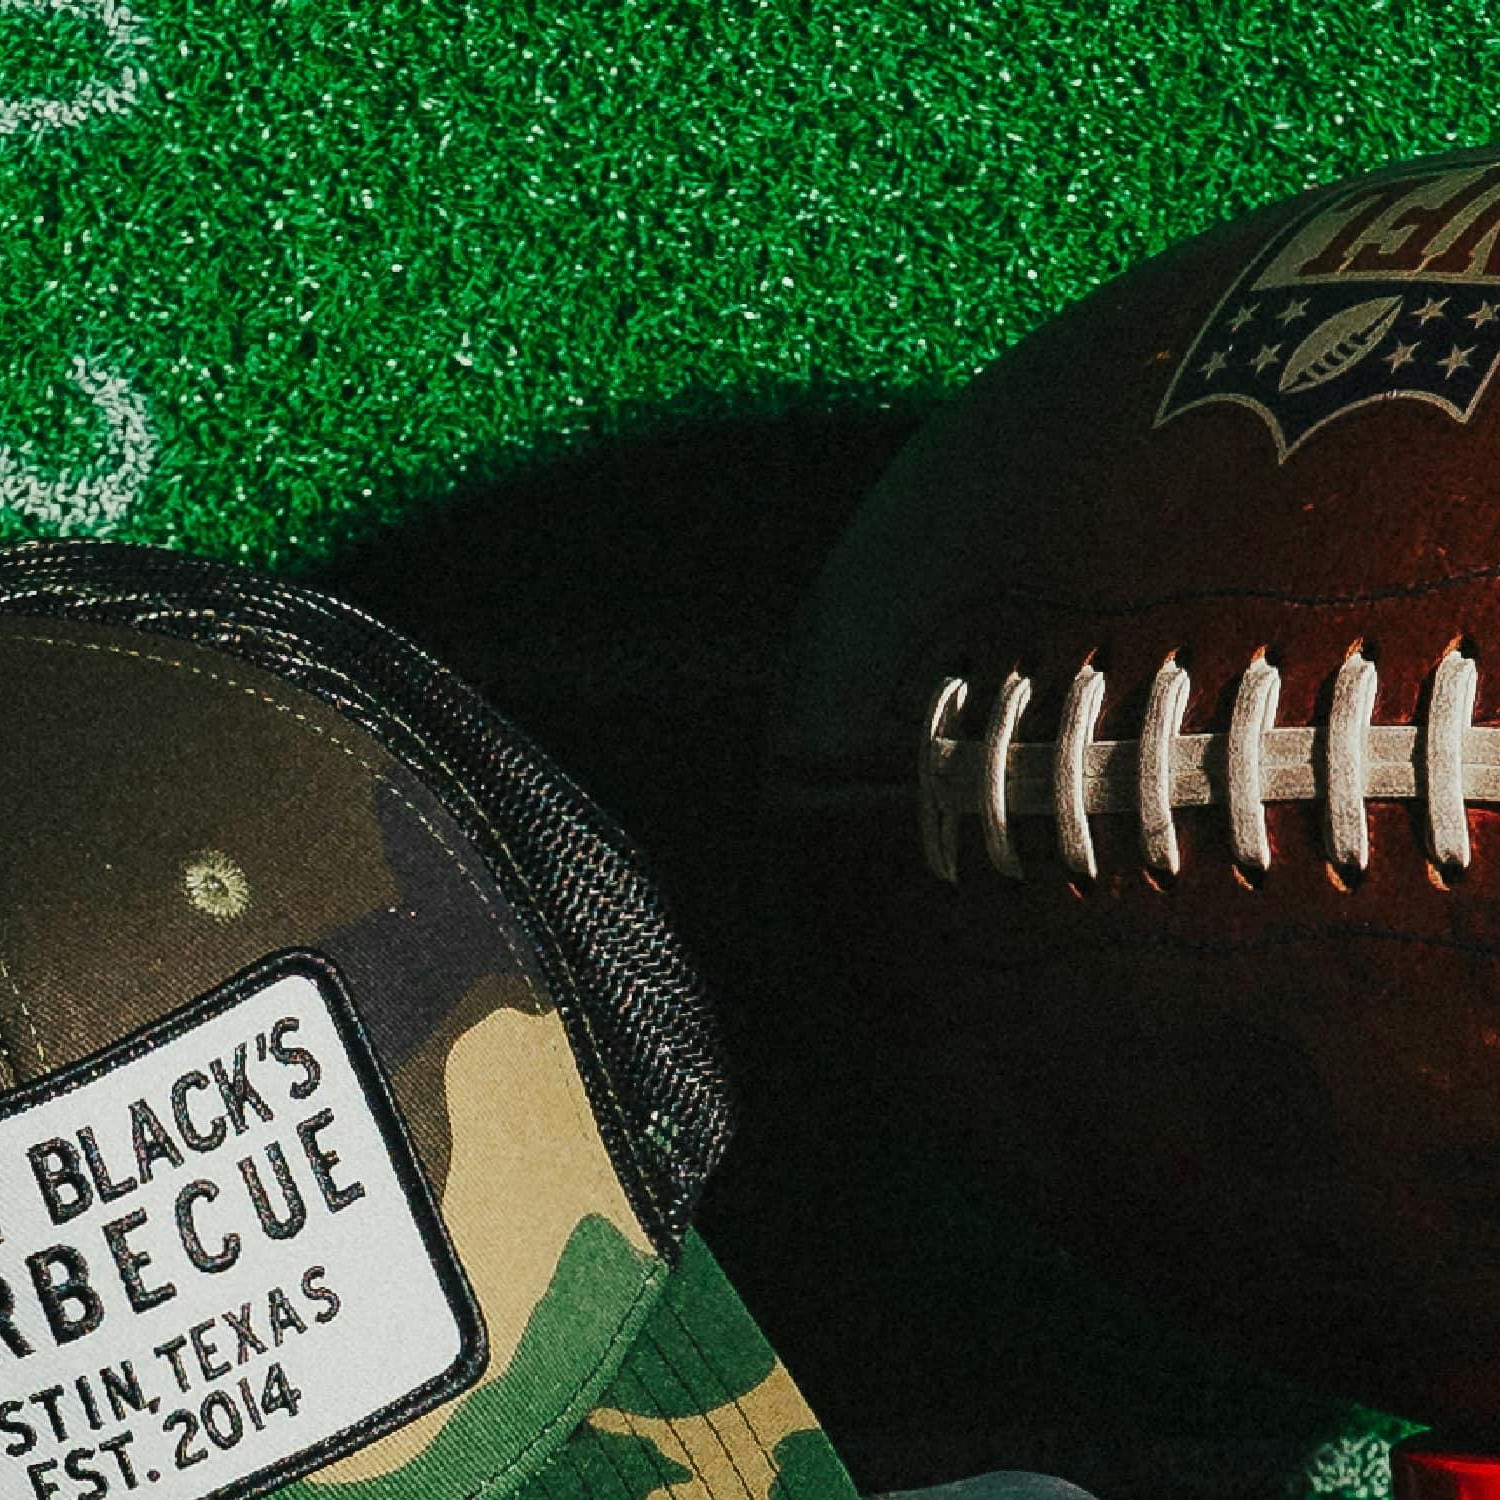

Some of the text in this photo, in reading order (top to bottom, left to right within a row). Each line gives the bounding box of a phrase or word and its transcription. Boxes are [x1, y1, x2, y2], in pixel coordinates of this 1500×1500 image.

[25, 1016, 325, 1227] BLACK'S
[153, 1264, 343, 1392] TEXAS
[162, 1362, 304, 1470] 2014
